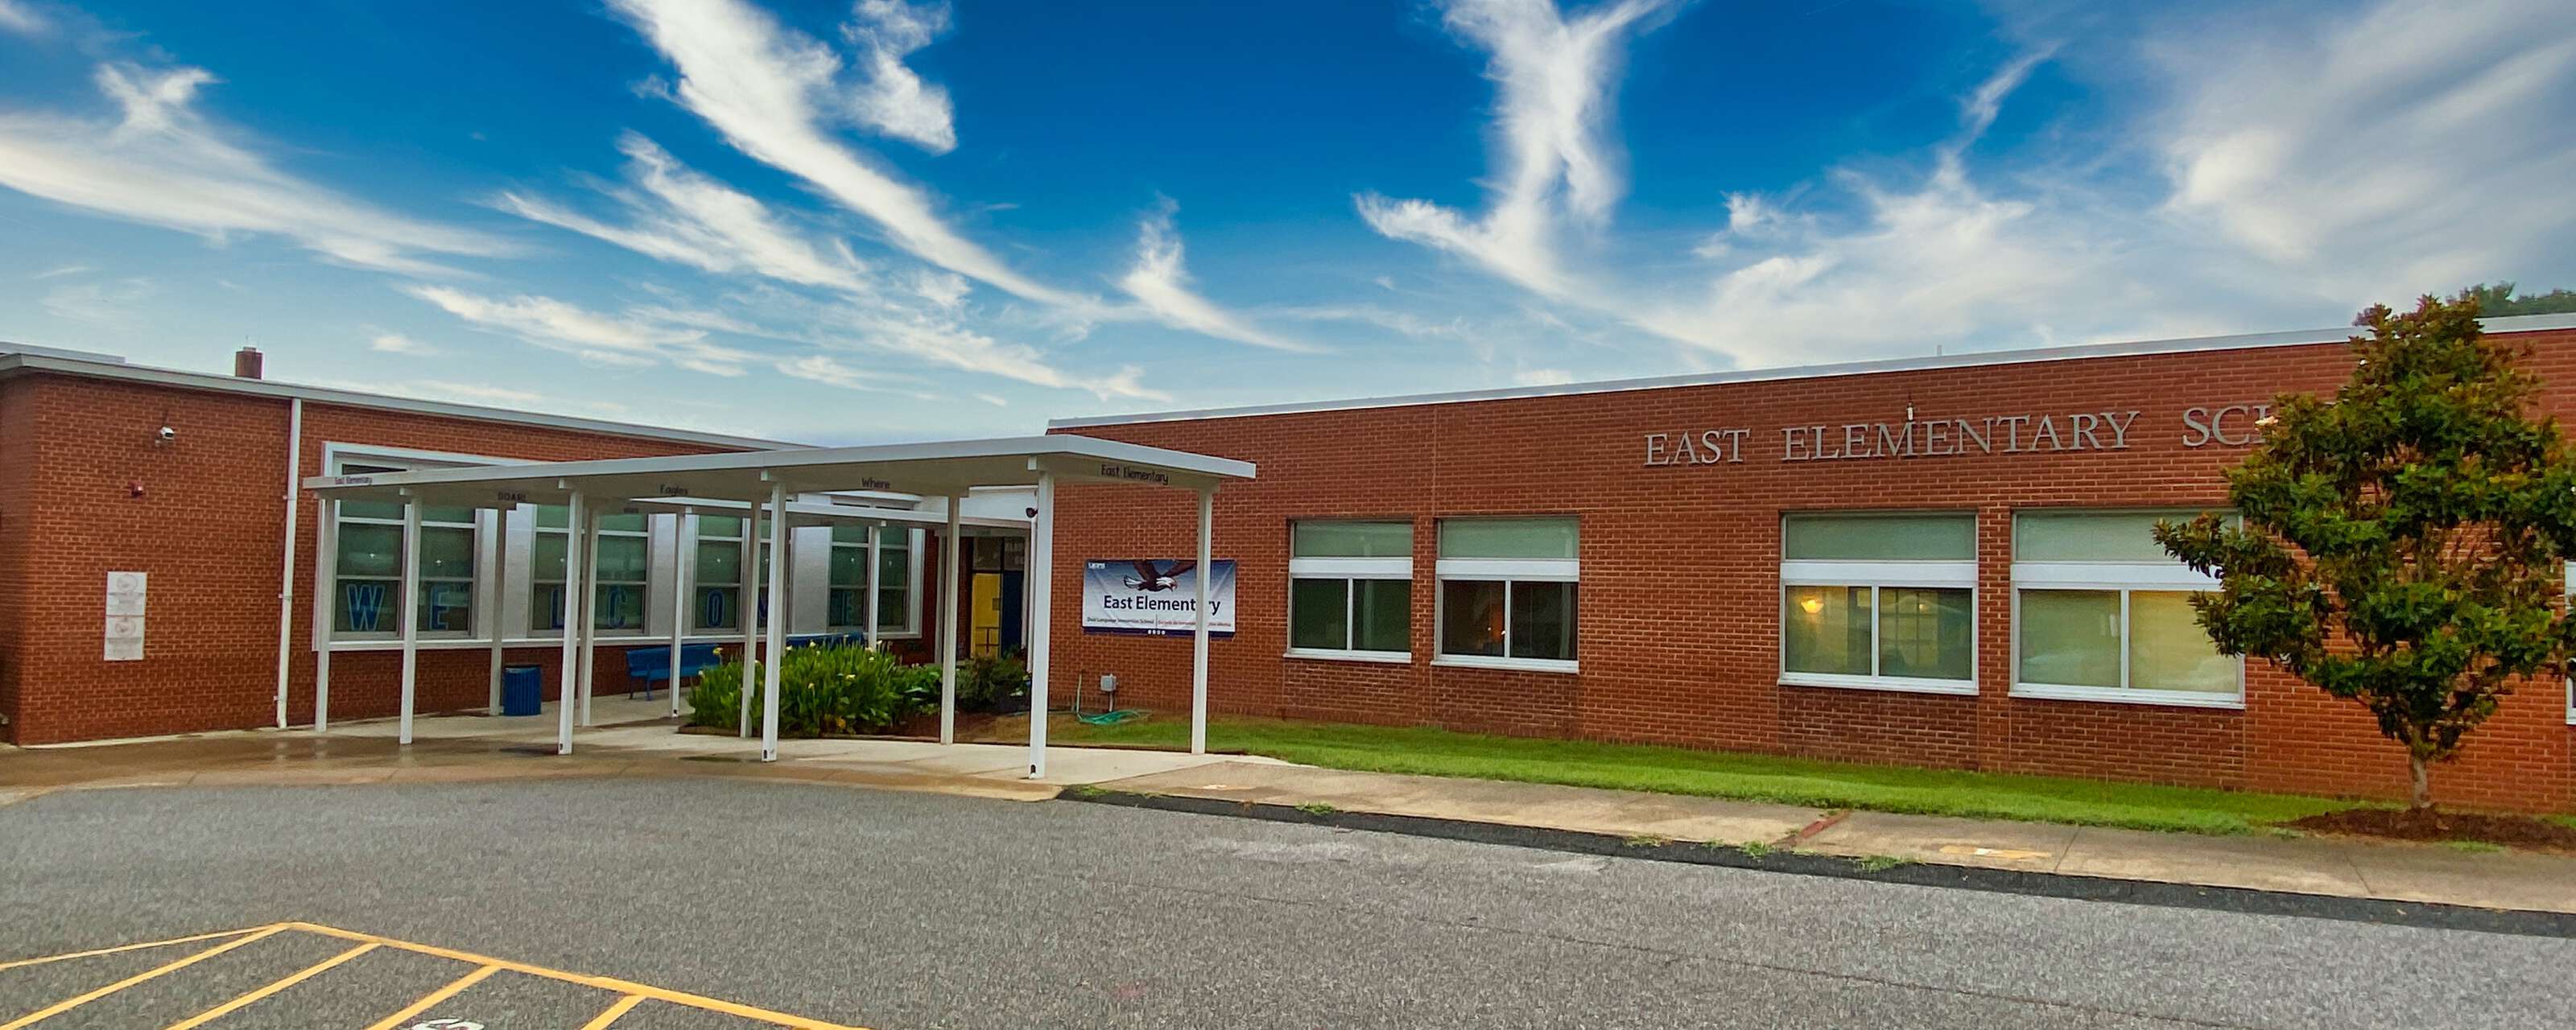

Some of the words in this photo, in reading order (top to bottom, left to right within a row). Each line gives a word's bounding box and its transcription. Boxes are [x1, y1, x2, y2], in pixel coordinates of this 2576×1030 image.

[1644, 428, 1751, 466] EAST
[1781, 410, 2140, 462] ELEMENTARY
[1101, 464, 1120, 477] East
[1124, 467, 1169, 485] Elementary
[1104, 595, 1133, 609] East
[1136, 595, 1220, 616] Elementy
